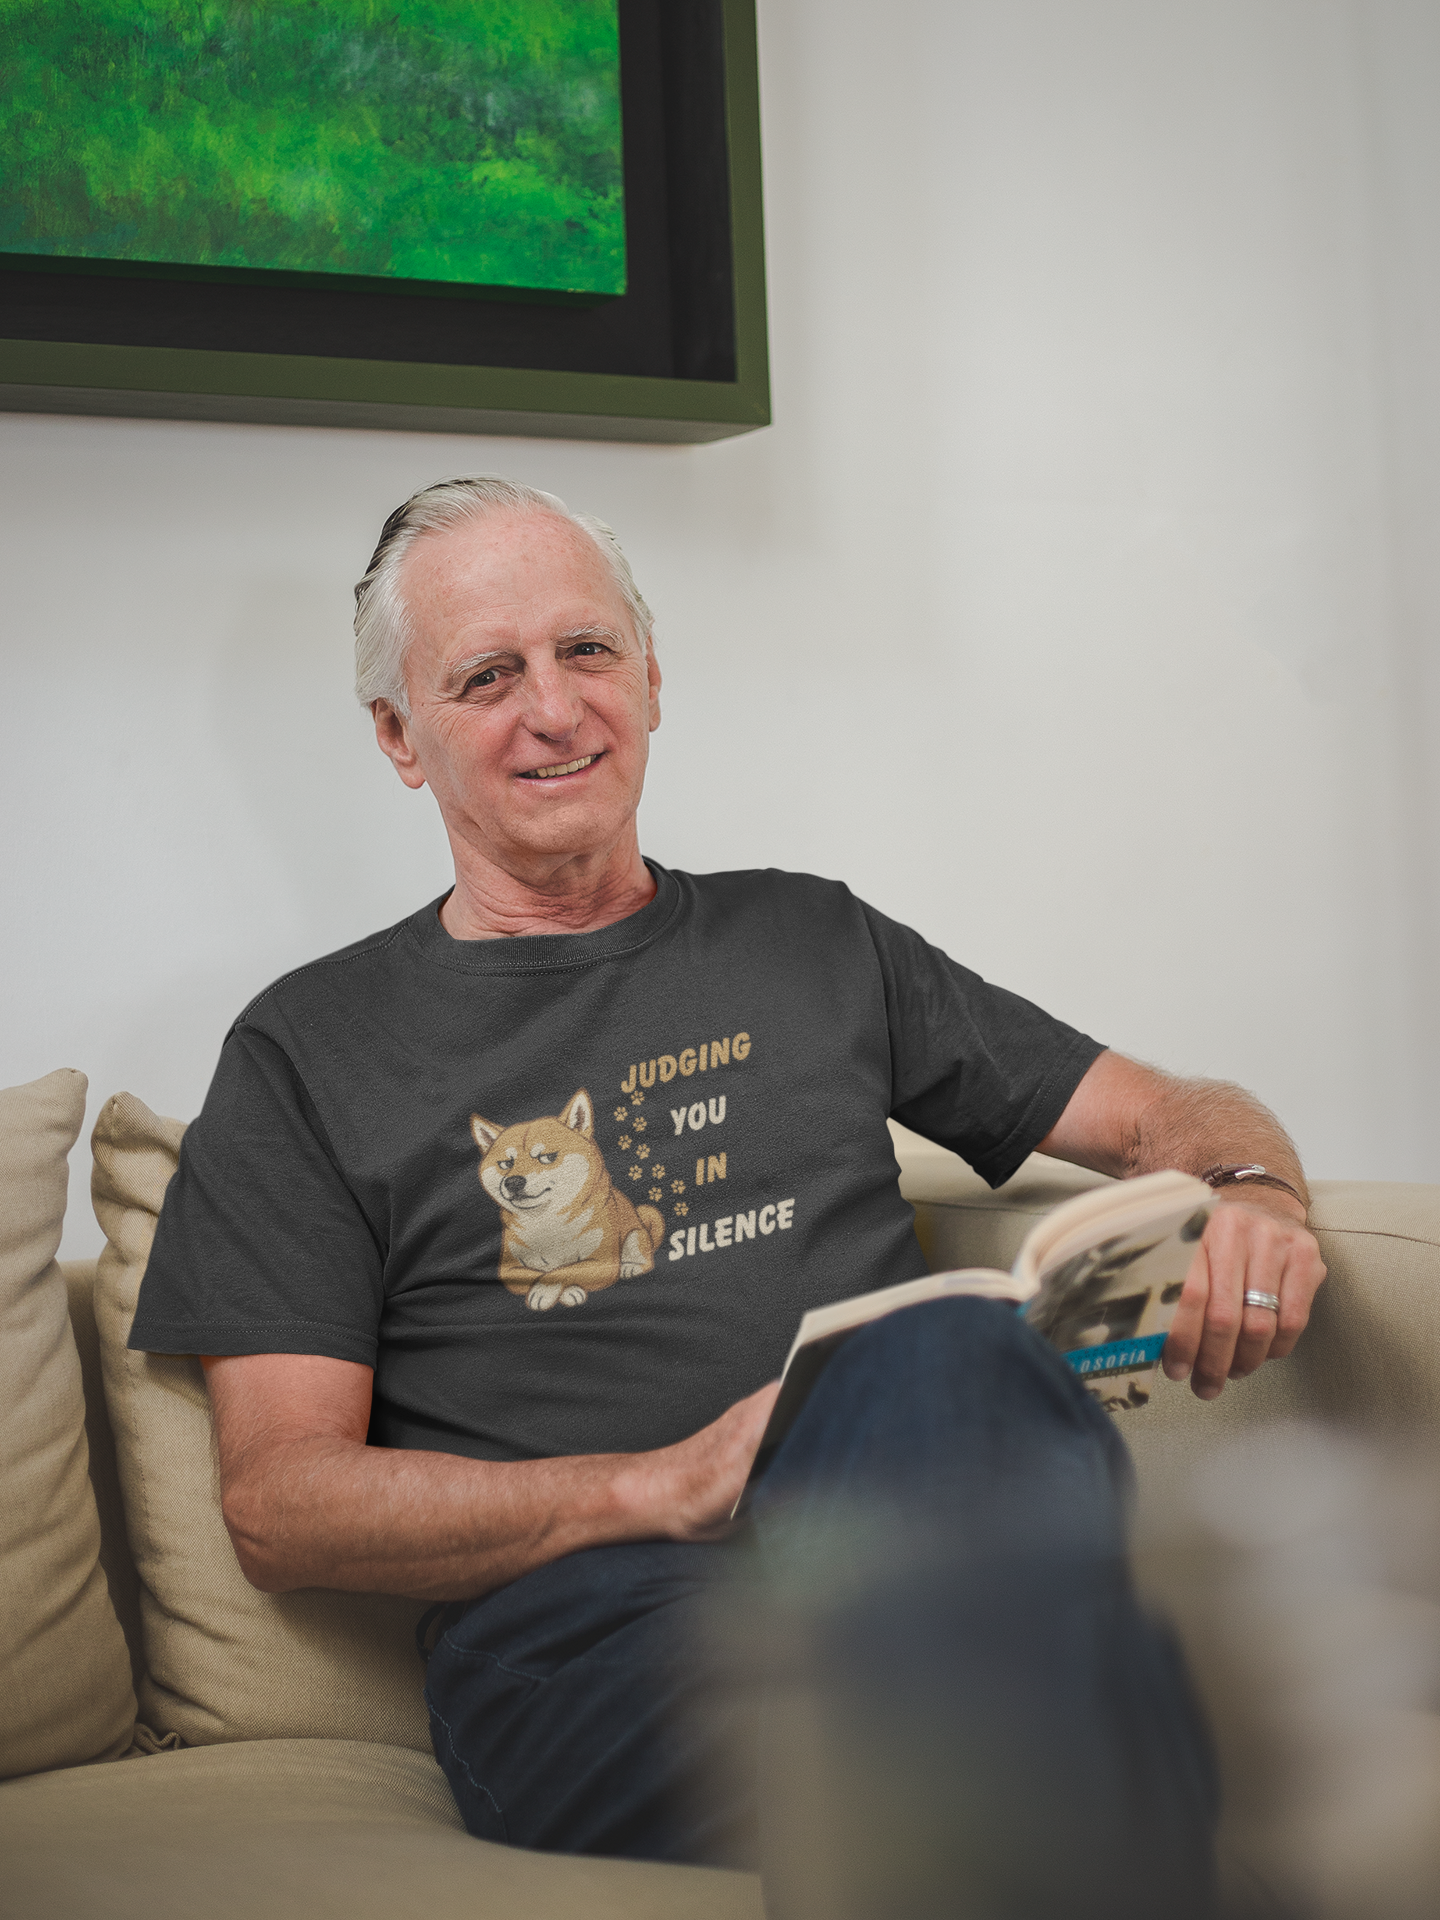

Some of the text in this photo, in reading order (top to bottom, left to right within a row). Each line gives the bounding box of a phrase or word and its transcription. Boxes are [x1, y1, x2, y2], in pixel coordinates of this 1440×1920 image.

[620, 1031, 752, 1094] JUDGING
[669, 1094, 727, 1136] YOU
[695, 1151, 728, 1186] IN
[667, 1197, 796, 1262] SILENCE
[1073, 1348, 1146, 1374] OSOFÍA
